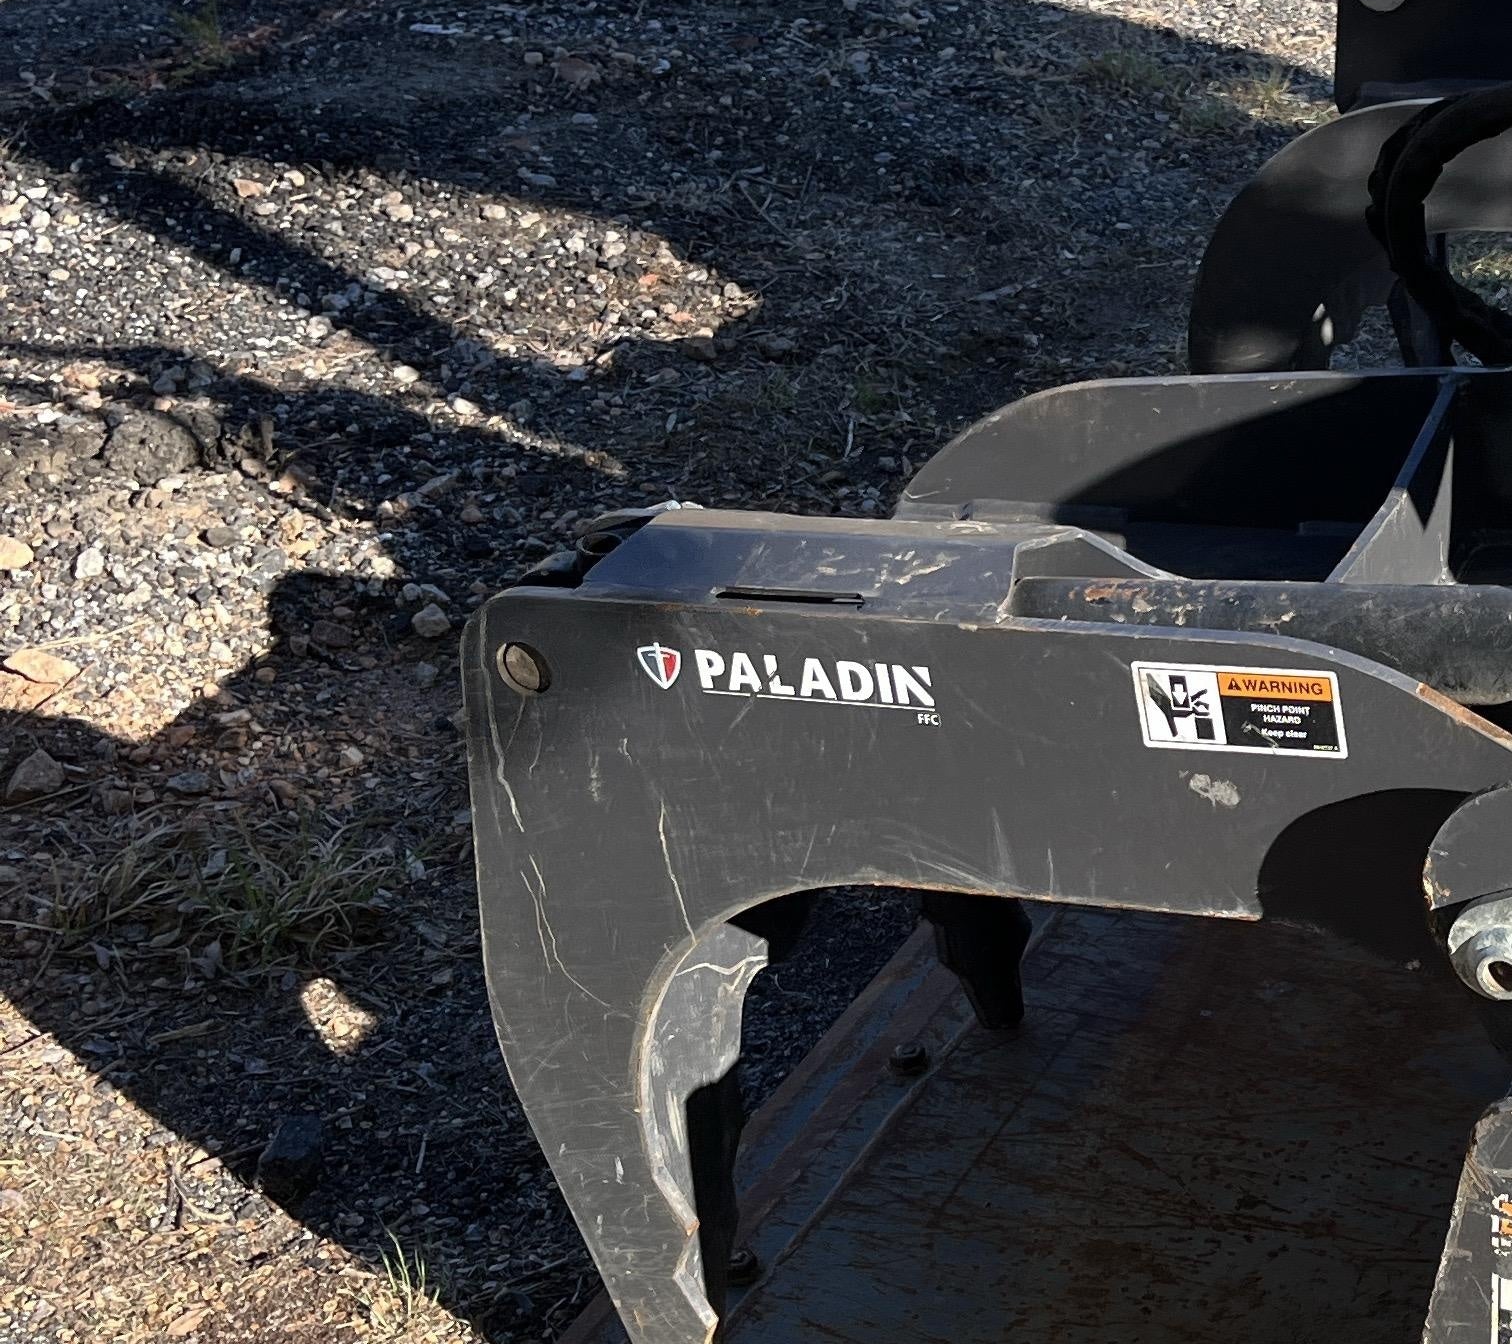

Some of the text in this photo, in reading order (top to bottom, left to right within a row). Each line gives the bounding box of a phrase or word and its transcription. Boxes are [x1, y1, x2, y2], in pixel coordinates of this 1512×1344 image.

[694, 649, 936, 707] PALADIN
[1242, 679, 1323, 695] WARNING
[1250, 704, 1310, 716] PINCH POINT
[917, 713, 940, 727] FFC
[1263, 714, 1302, 725] HAZARD
[1261, 728, 1307, 740] Keep clear
